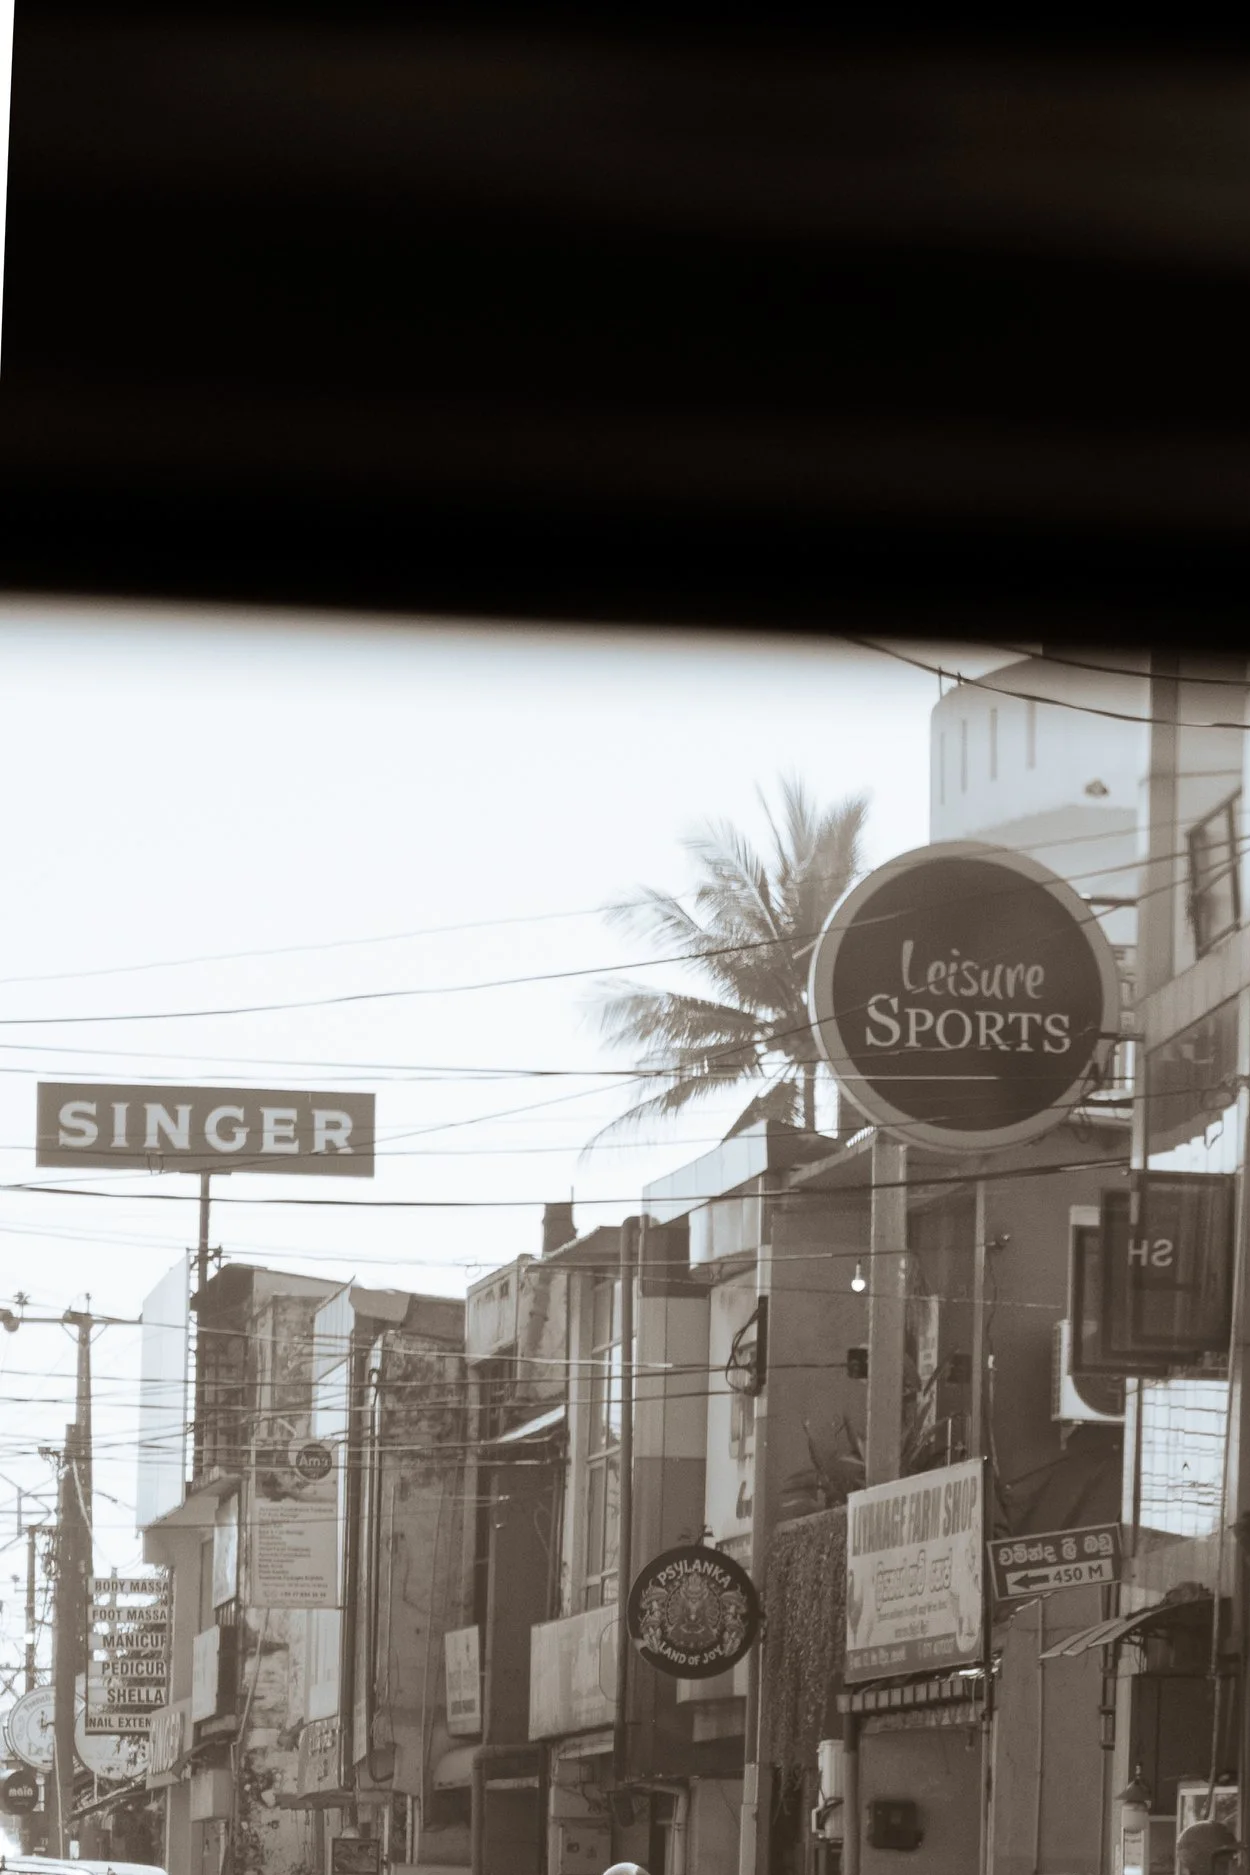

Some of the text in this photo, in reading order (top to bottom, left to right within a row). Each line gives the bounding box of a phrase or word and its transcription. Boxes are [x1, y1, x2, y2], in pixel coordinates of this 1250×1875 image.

[901, 939, 1046, 1000] Leisure
[865, 993, 1071, 1054] SPORTS
[58, 1100, 355, 1155] SINGER
[942, 1475, 978, 1538] SHOP
[95, 1581, 126, 1593] BODY
[657, 1559, 732, 1589] PSYLANKA
[1053, 1564, 1104, 1583] 450 M
[92, 1608, 122, 1622] FOOT
[658, 1640, 725, 1666] LAND OF JOY
[88, 1717, 114, 1729] NAIL
